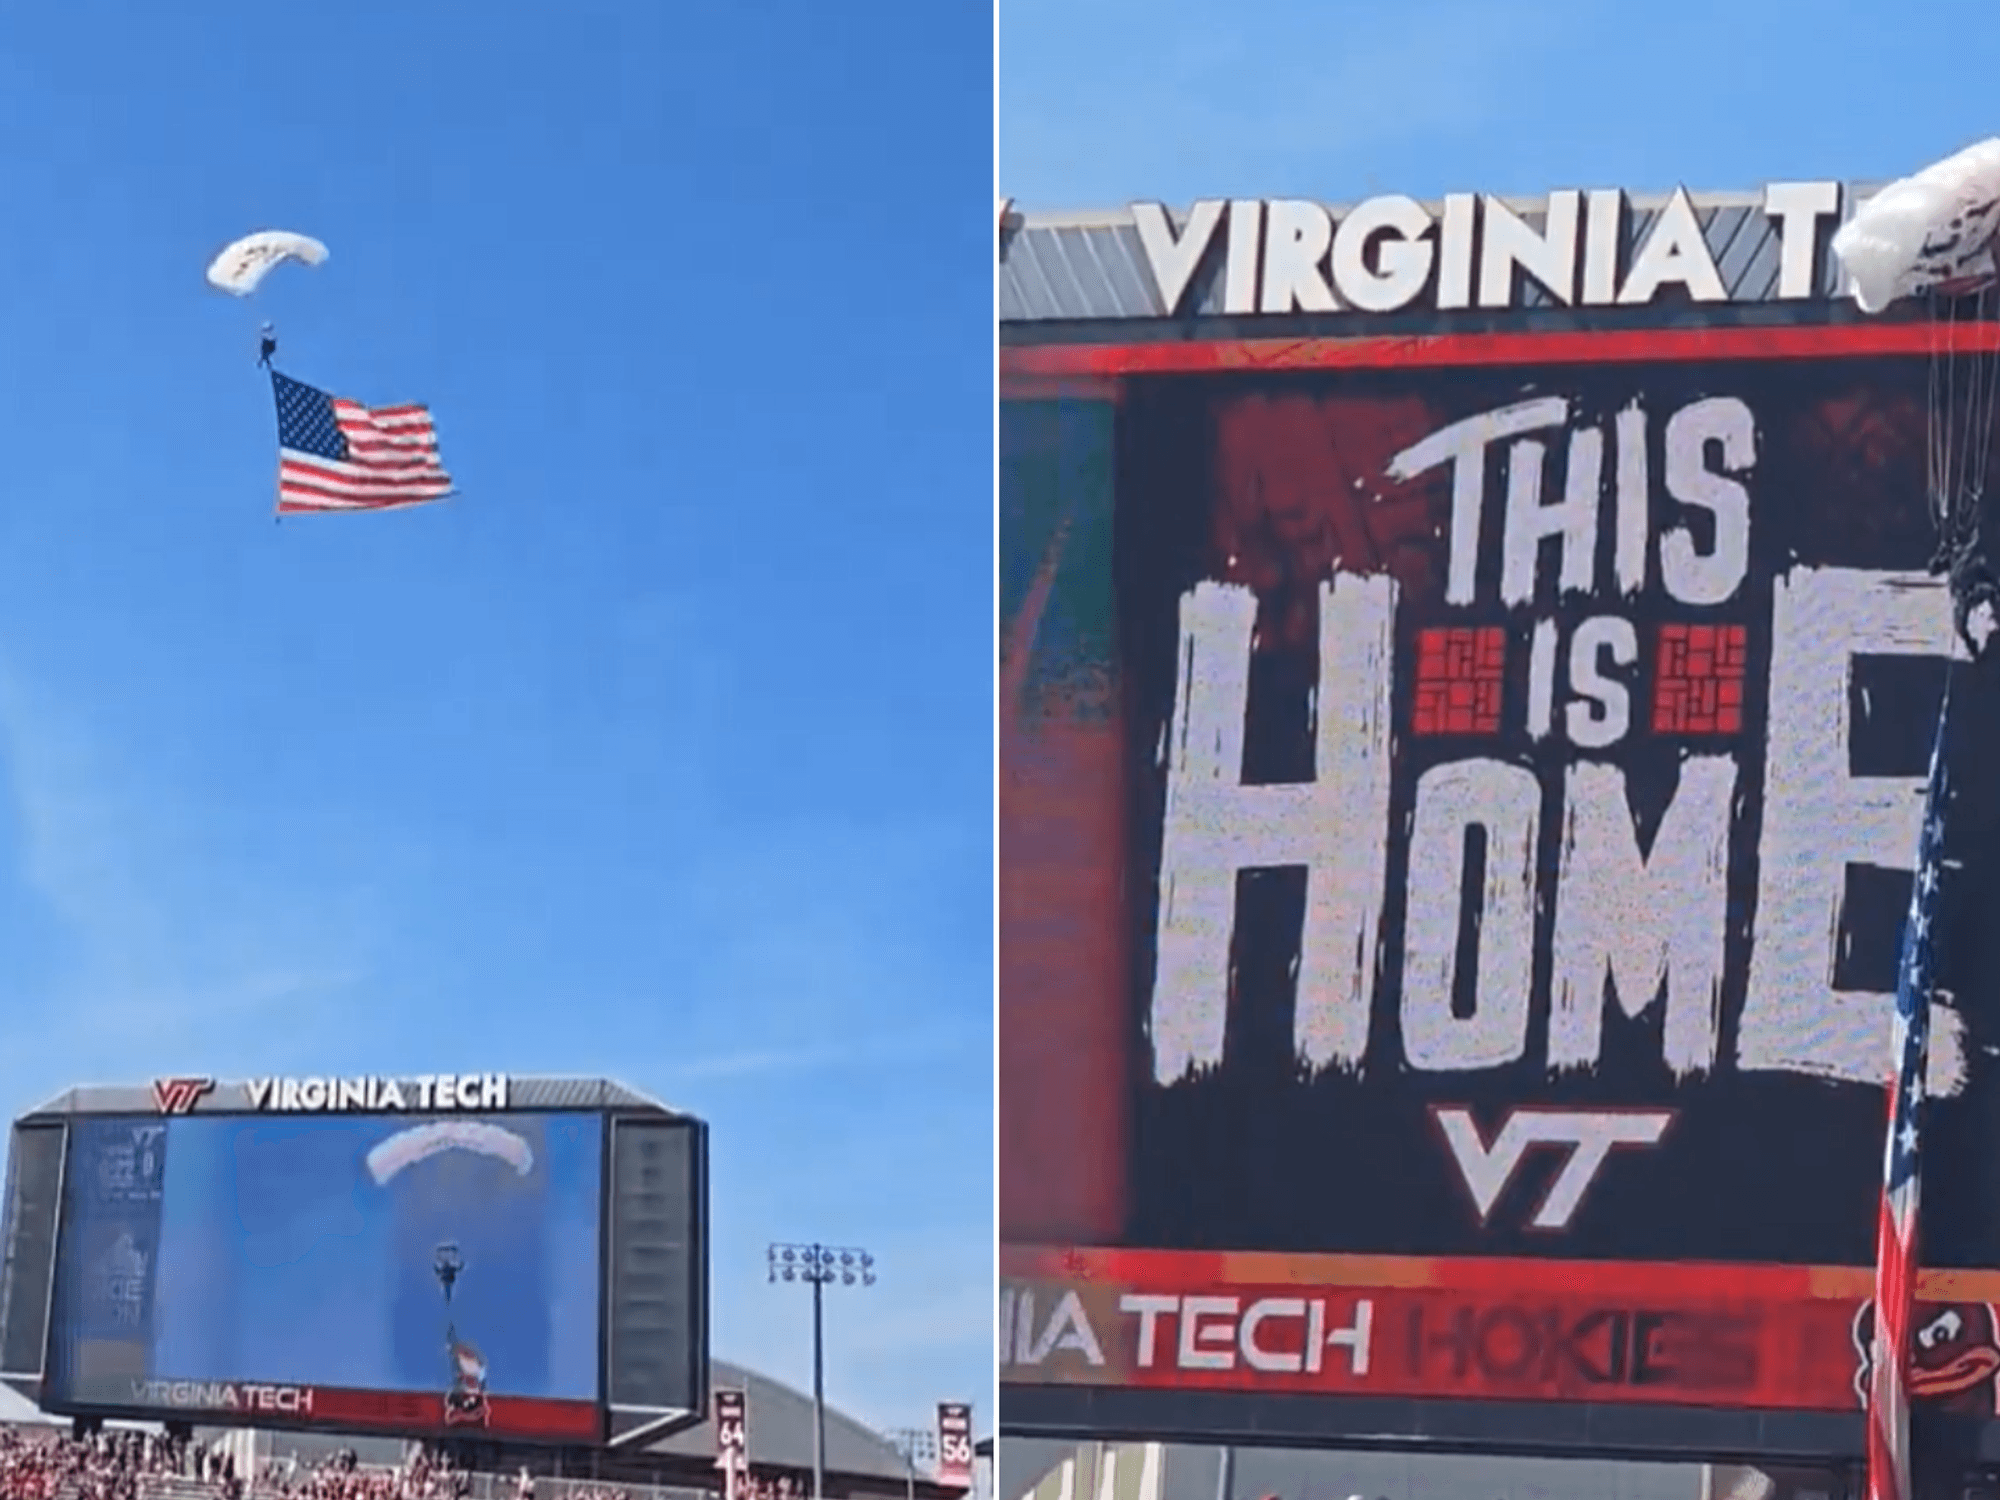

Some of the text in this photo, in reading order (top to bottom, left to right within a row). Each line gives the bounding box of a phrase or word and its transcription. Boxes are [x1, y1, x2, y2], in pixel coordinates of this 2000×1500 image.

[1132, 184, 1730, 317] VIRGINIA
[1384, 395, 1758, 607] THIS
[1527, 615, 1638, 748] IS
[1151, 567, 1968, 1098] HOME
[154, 1077, 215, 1114] VT
[246, 1073, 508, 1110] VIRGINIA TECH
[1437, 1108, 1673, 1228] VT
[1119, 1294, 1374, 1375] TECH
[130, 1378, 314, 1412] VIRGINIA TECH
[719, 1421, 745, 1446] 64
[942, 1434, 970, 1462] 56
